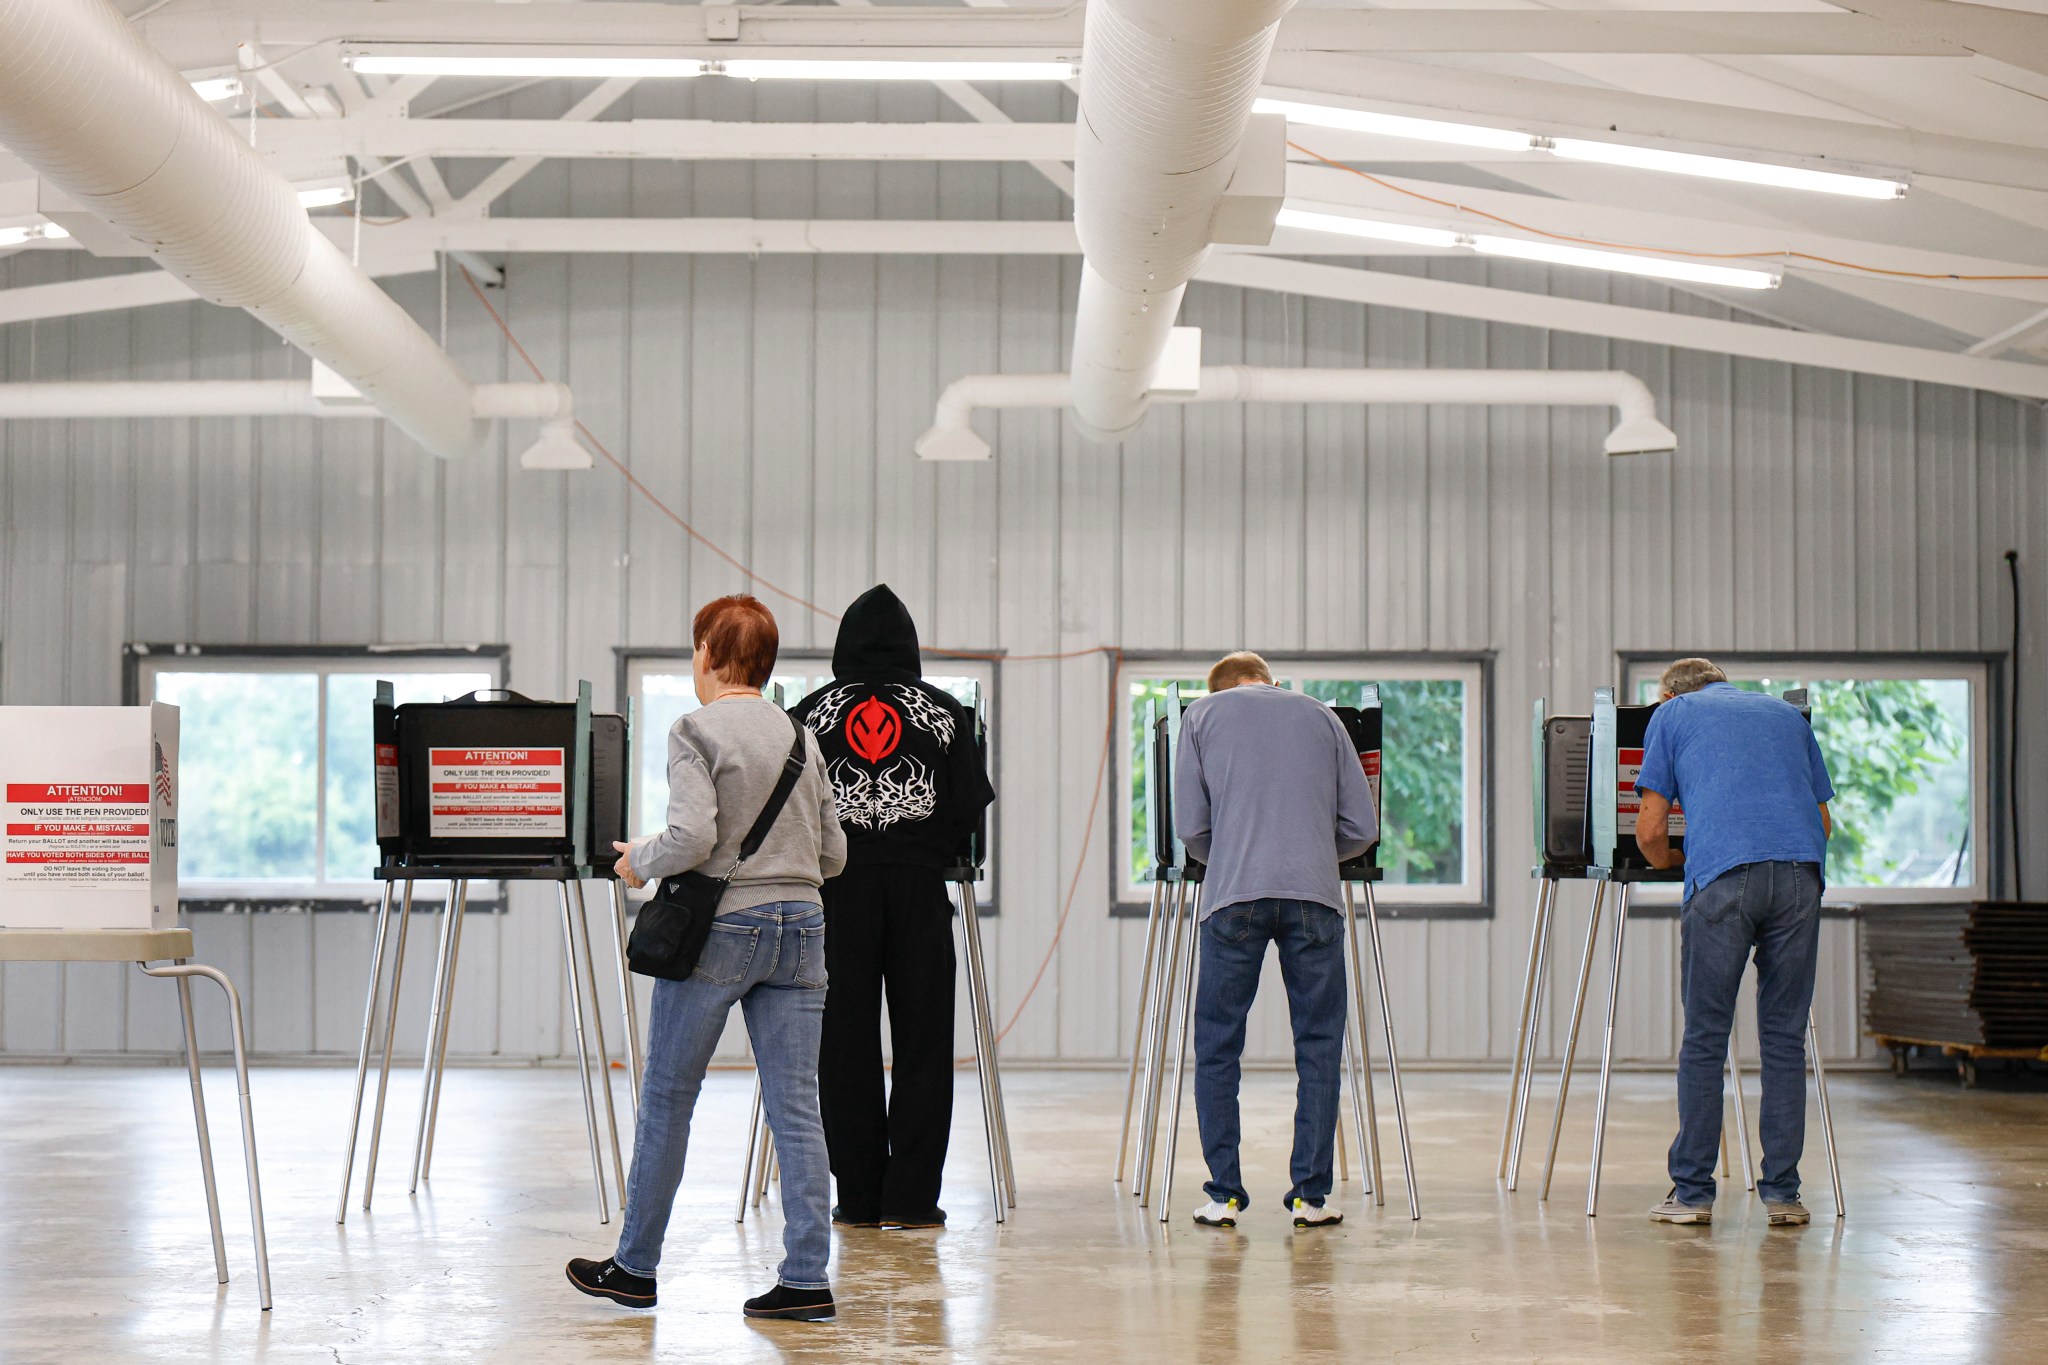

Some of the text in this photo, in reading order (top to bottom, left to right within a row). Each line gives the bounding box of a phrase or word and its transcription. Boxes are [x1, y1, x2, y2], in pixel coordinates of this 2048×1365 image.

[465, 751, 528, 760] ATTENTION!
[443, 769, 550, 777] ONLY USE THE PEN PROVIDED!
[46, 785, 123, 796] ATTENTION!
[20, 808, 149, 816] ONLY USE THE PEN PROVIDED!
[34, 824, 135, 832] IF YOU MAKE A MISTAKE:
